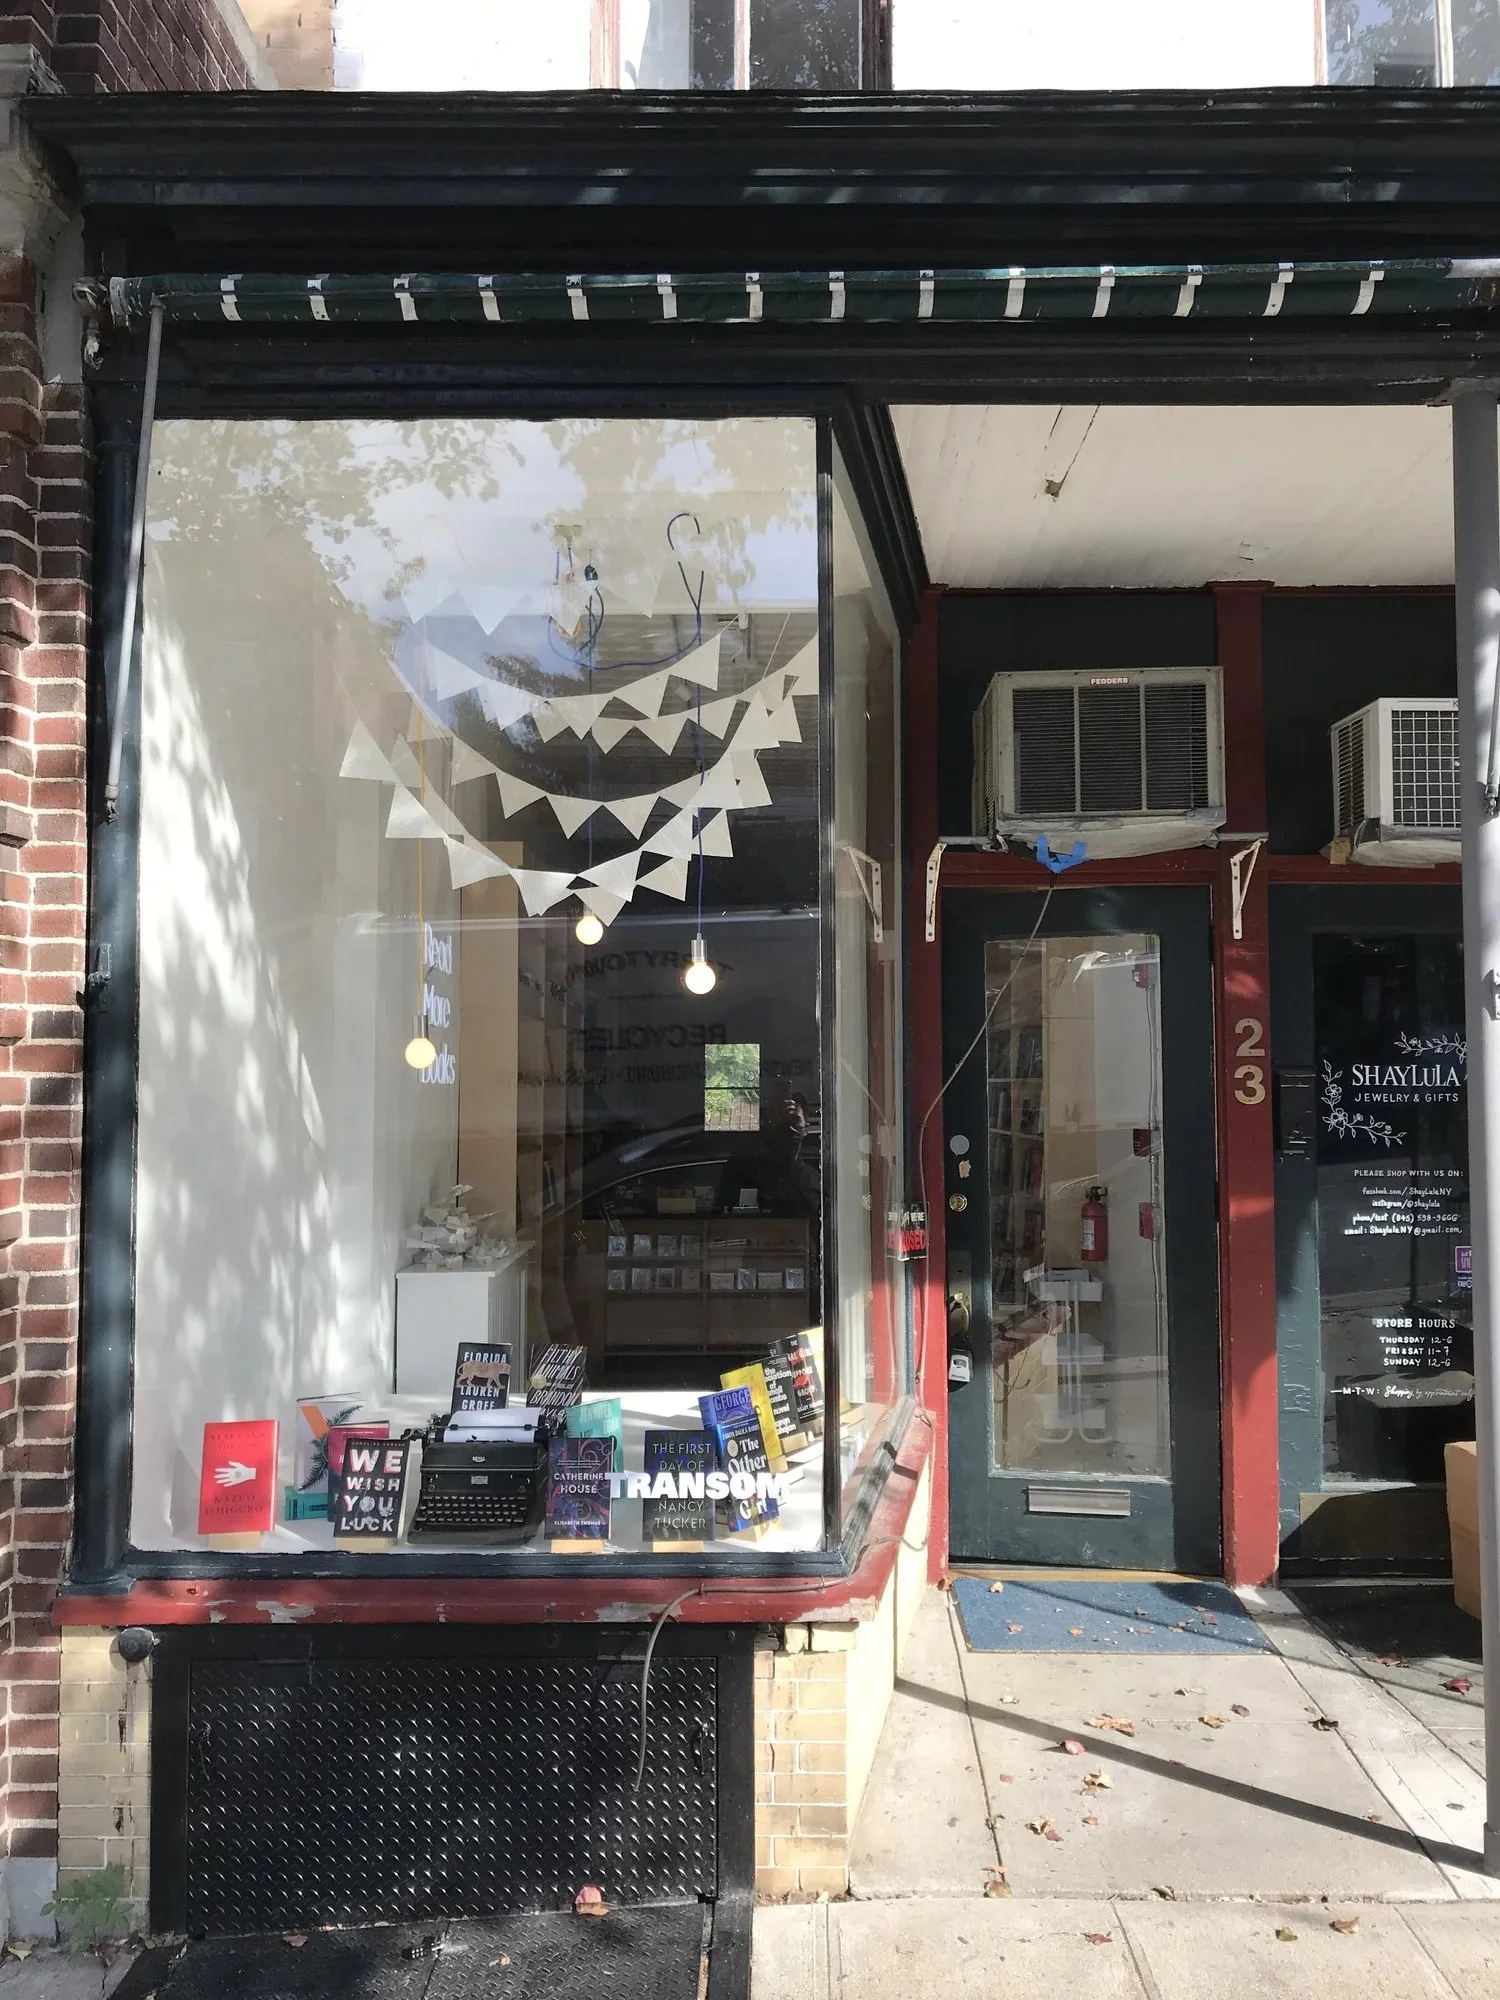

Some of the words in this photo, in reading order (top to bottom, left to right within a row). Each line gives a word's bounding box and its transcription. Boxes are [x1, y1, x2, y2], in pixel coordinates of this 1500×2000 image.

[1090, 677, 1129, 685] FEDDERS
[424, 921, 453, 975] Read
[423, 983, 451, 1028] More
[1354, 1093, 1410, 1103] JEWELRY
[1413, 1093, 1420, 1103] &
[1424, 1093, 1459, 1103] GIFTS
[1354, 1169, 1384, 1177] PLEASE
[1387, 1169, 1407, 1177] SHOP
[1409, 1169, 1430, 1177] WITH
[1391, 1213, 1414, 1224] (845)
[1376, 1318, 1413, 1328] STORE
[1419, 1318, 1456, 1329] HOURS
[1431, 1337, 1453, 1345] 12-6
[463, 1351, 508, 1364] FLORIDA
[543, 1345, 583, 1364] FILTHY
[1383, 1358, 1421, 1367] SUNDAY
[1428, 1358, 1451, 1367] 12-6
[764, 1367, 776, 1376] the
[769, 1380, 777, 1389] of
[459, 1386, 500, 1398] LAUREN
[768, 1385, 784, 1397] mall
[530, 1389, 581, 1407] BRANDON
[769, 1393, 788, 1404] ombs
[461, 1399, 496, 1411] GROFF
[652, 1443, 676, 1458] THE
[678, 1443, 712, 1459] FIRST
[739, 1438, 760, 1453] The
[350, 1449, 404, 1474] WE
[660, 1461, 684, 1472] DAY
[686, 1461, 705, 1472] OF
[728, 1454, 768, 1475] Other
[553, 1472, 604, 1481] CATHERINE
[346, 1476, 401, 1491] WISH
[560, 1484, 598, 1494] HOUSE
[604, 1472, 789, 1500] TRANSOM
[204, 1504, 263, 1517] ISHIGURO
[343, 1495, 397, 1515] YOU
[658, 1500, 705, 1513] NANCY
[341, 1516, 394, 1532] LUCK
[653, 1517, 706, 1530] TUCKER
